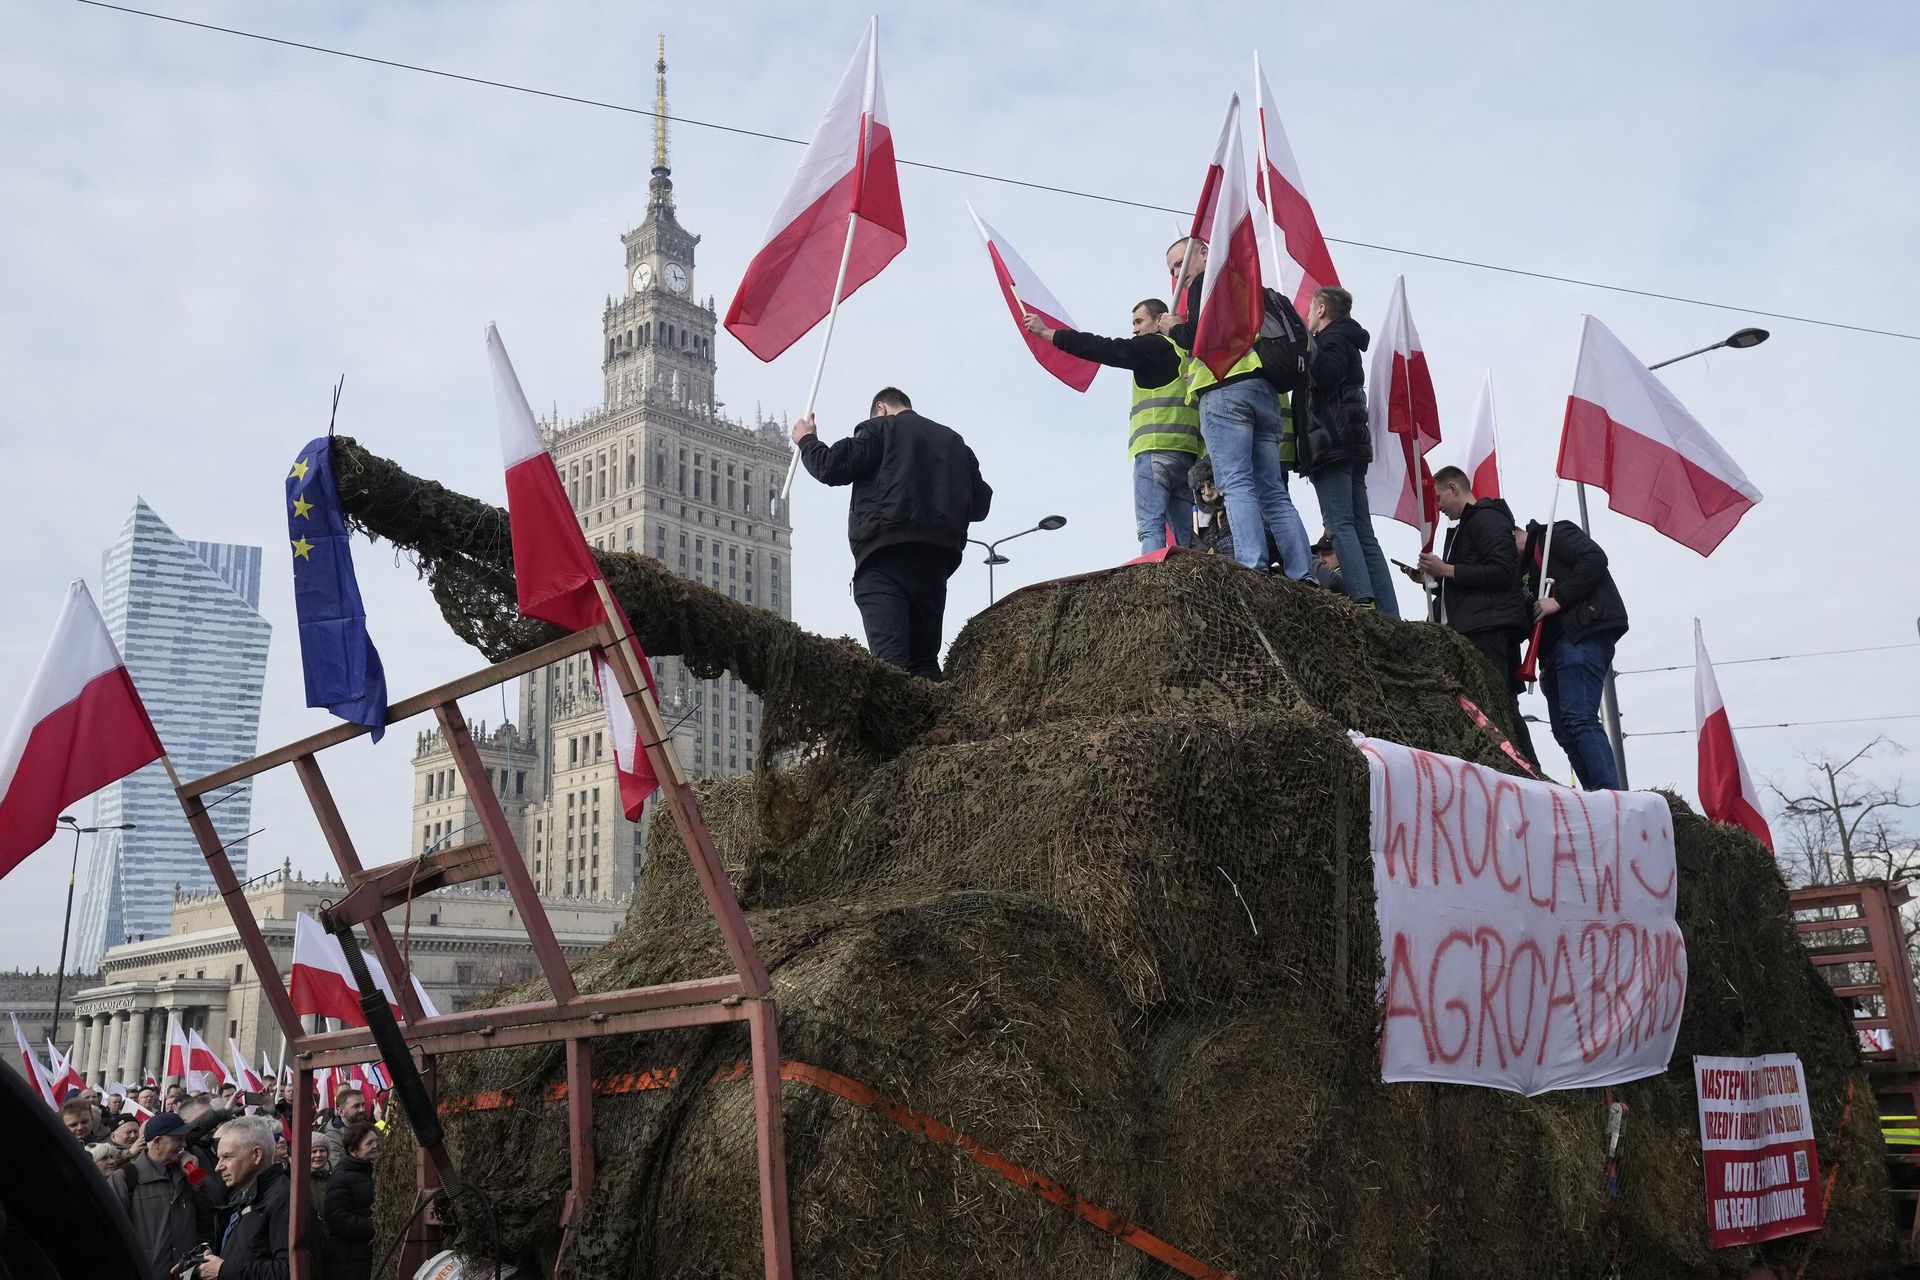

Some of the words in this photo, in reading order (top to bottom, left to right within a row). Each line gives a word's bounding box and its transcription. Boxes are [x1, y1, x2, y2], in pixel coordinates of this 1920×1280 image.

[1361, 744, 1621, 913] WROCŁAW
[1704, 1111, 1733, 1144] URZĘDY
[1724, 1162, 1755, 1192] AUTA
[1714, 1199, 1731, 1230] NIE
[1729, 1197, 1758, 1232] BĘDĄ
